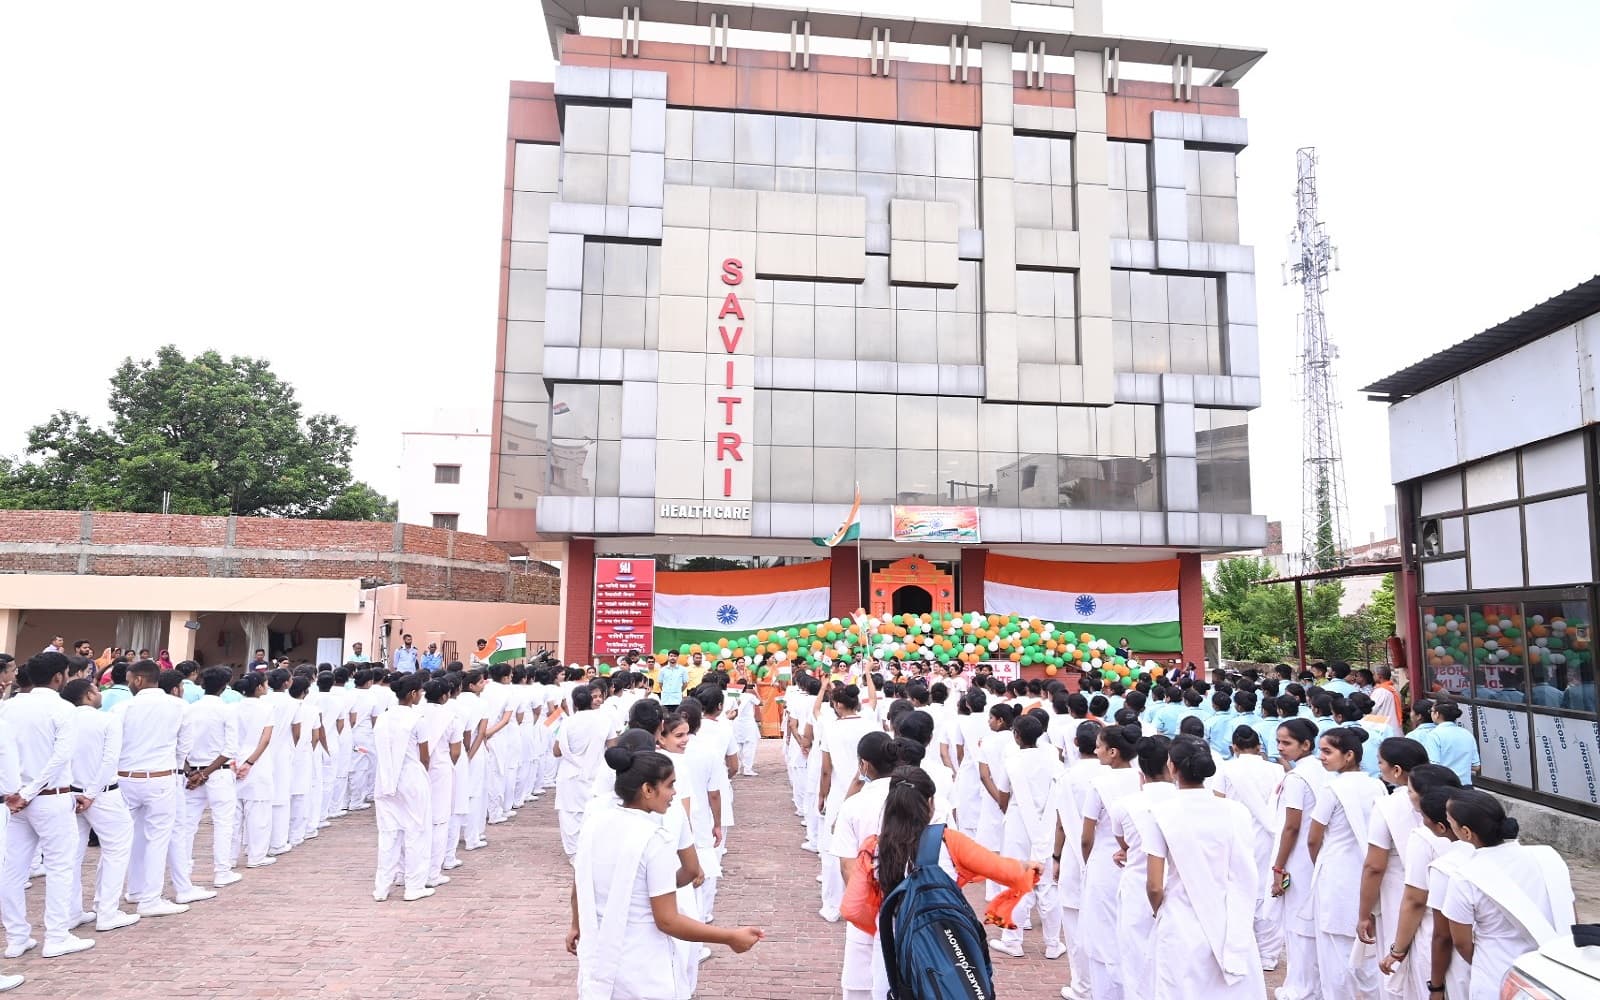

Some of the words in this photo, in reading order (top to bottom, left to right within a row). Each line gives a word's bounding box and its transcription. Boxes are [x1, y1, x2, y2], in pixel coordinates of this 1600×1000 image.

[716, 258, 745, 497] SAVITRI
[660, 504, 712, 519] HEALTH
[714, 506, 750, 520] CARE
[1541, 735, 1559, 794] CROSSBOND
[1579, 741, 1598, 803] CROSSBOND
